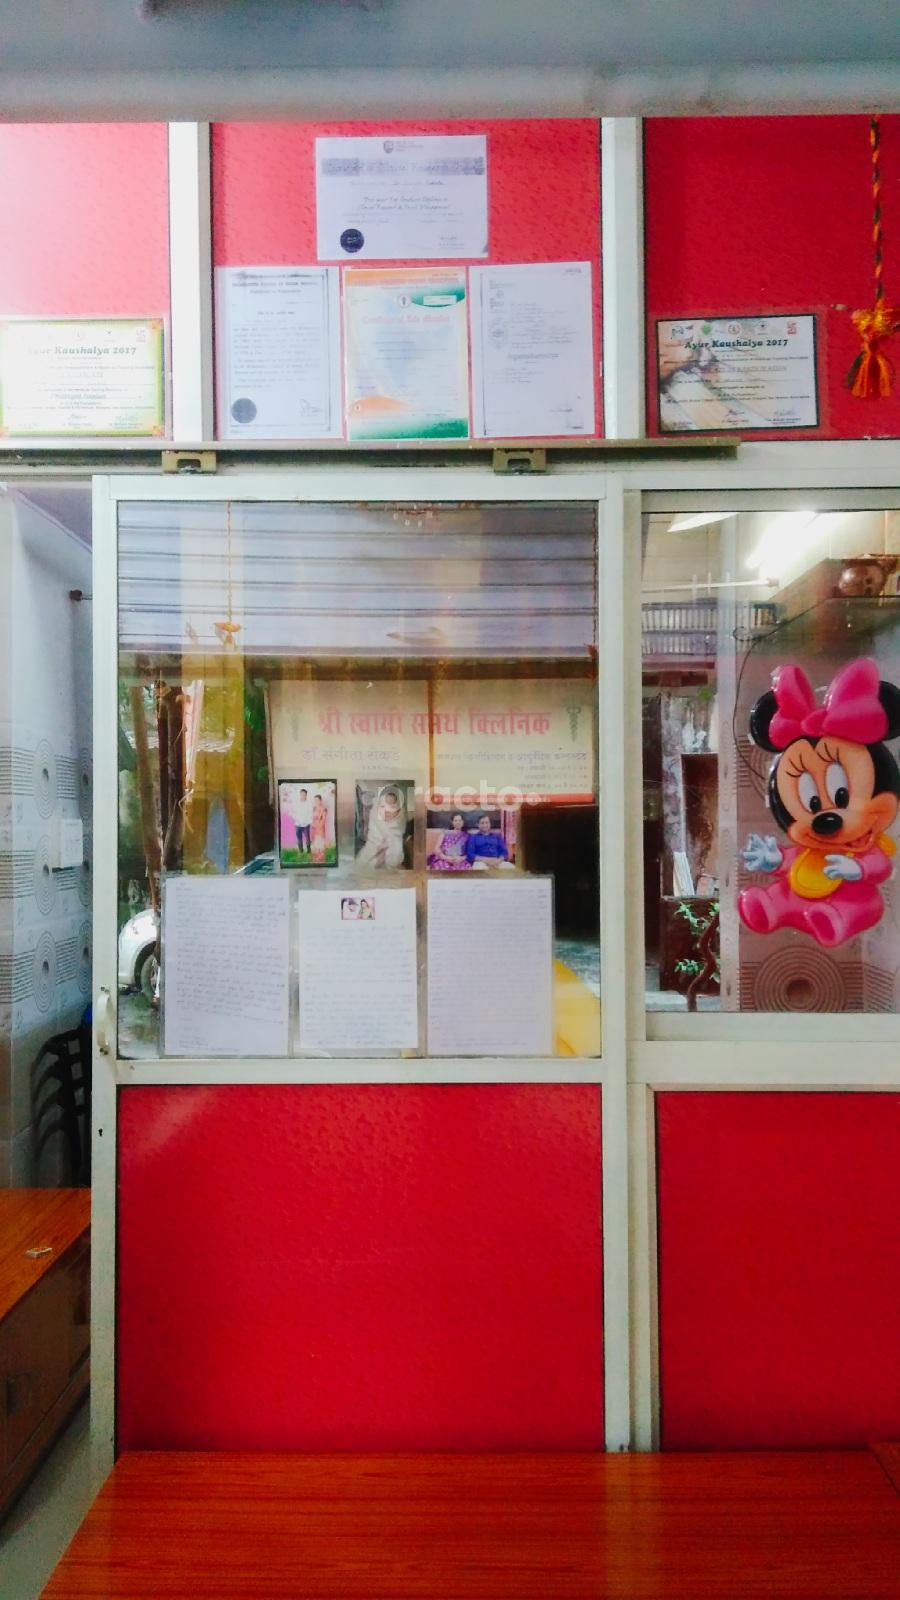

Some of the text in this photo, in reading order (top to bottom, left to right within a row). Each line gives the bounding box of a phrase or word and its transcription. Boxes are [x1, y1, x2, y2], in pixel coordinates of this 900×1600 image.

[684, 338, 789, 350] Ayur Kaushalya 2017
[54, 346, 110, 356] Kaushalya
[113, 346, 137, 356] 2017
[319, 705, 342, 735] श्री
[349, 706, 404, 735] स्वामी
